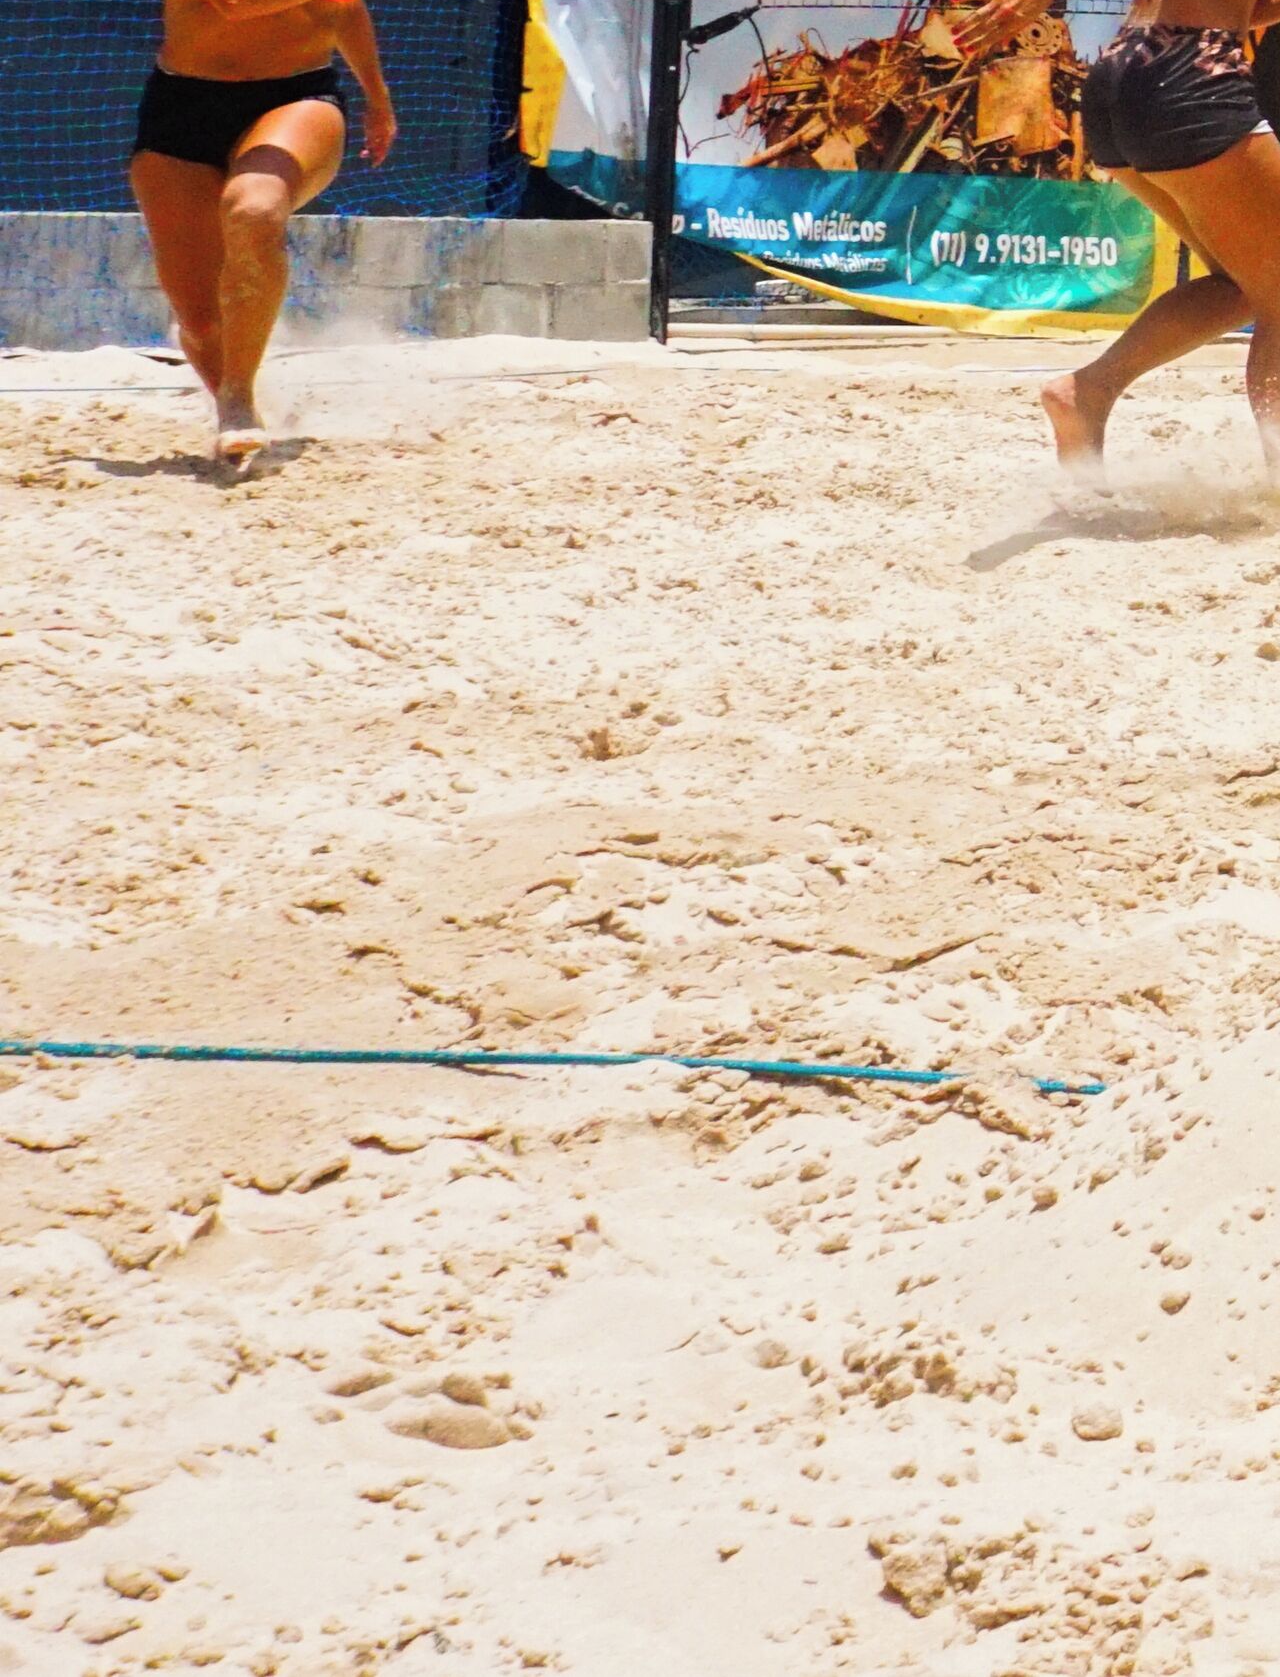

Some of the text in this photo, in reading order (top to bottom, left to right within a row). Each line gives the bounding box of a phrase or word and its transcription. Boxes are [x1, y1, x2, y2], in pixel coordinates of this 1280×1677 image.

[706, 206, 791, 242] Resíduos
[791, 209, 888, 243] Metálicos
[930, 229, 1119, 267] (11) 9.9131-1950
